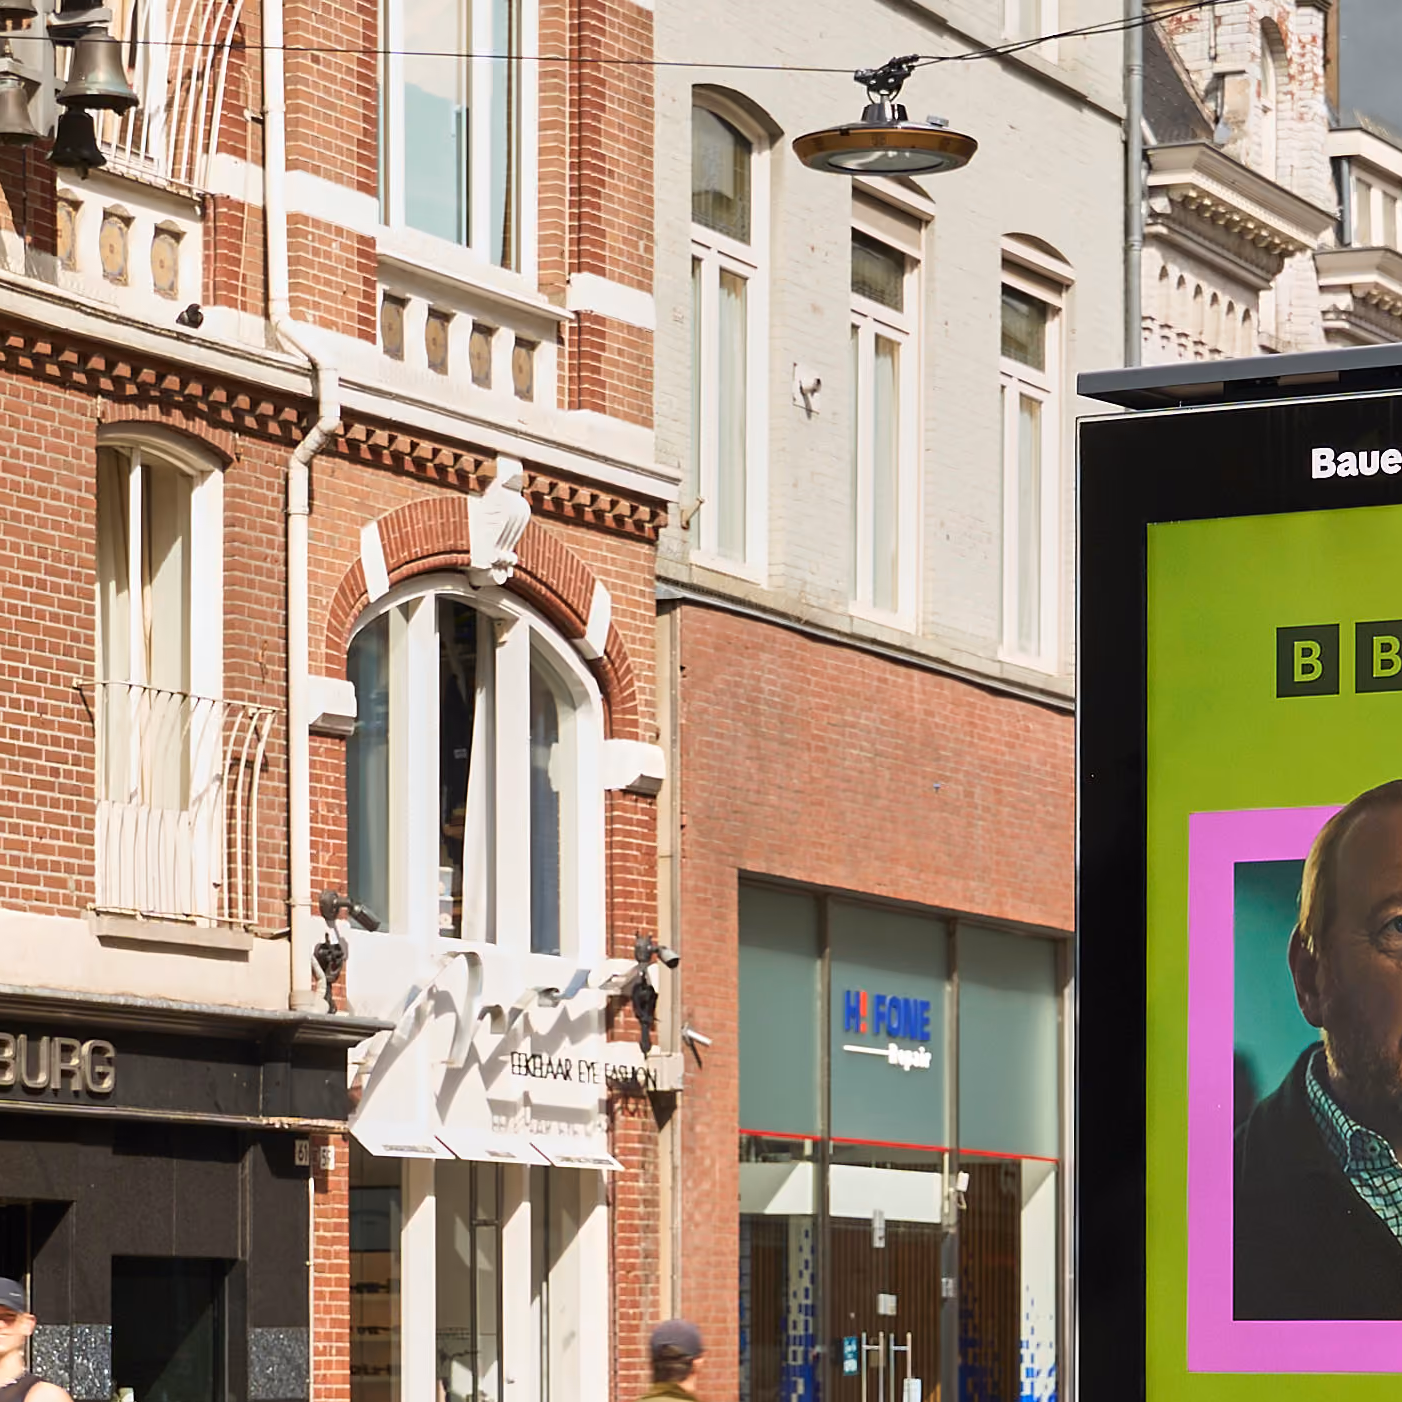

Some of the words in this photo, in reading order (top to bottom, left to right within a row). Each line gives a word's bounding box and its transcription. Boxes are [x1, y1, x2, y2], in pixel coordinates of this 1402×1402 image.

[873, 993, 931, 1042] FONE
[887, 1043, 932, 1071] Repair
[578, 1059, 601, 1085] EYE
[604, 1062, 658, 1092] FASHION
[298, 1143, 308, 1162] 61
